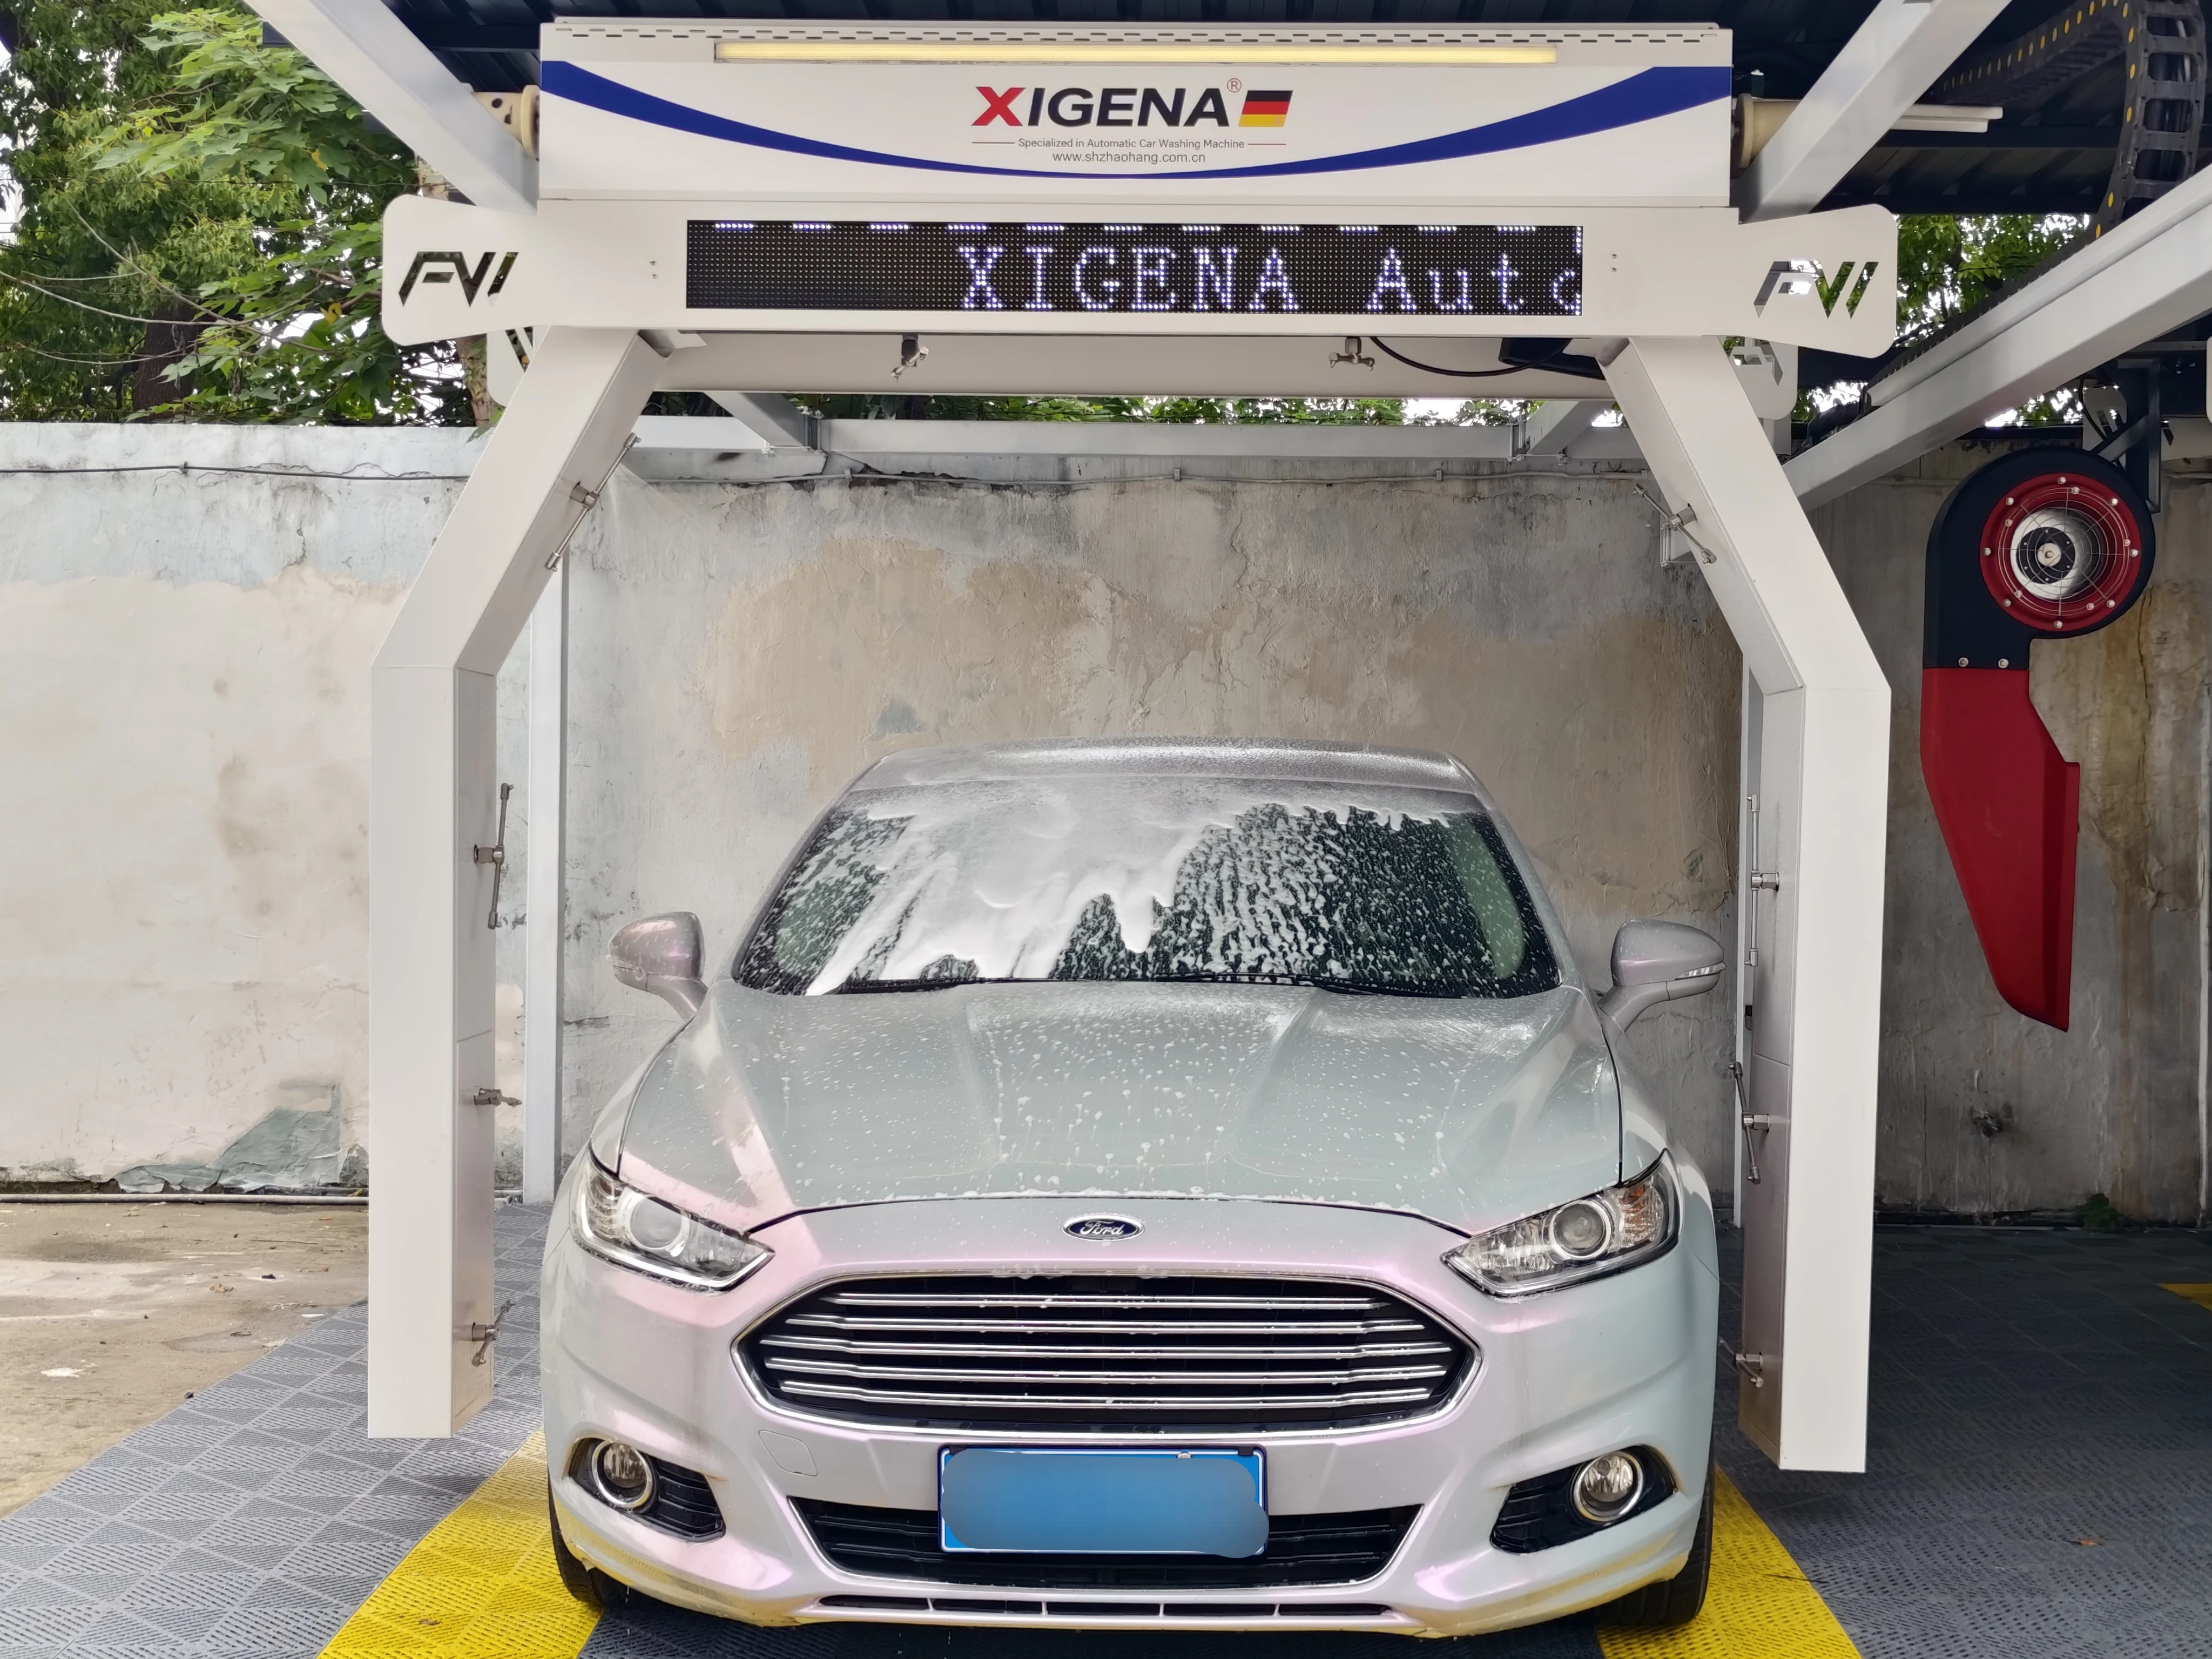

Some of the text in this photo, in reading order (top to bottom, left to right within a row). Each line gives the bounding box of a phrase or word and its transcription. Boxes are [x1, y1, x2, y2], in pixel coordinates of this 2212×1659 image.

[972, 86, 1230, 127] XIGENA
[1018, 138, 1245, 151] Specialized in Automatic Car Washing Machine
[1052, 151, 1206, 165] www.shzhaohang.com.cn
[959, 246, 1299, 309] XIGENA
[1080, 1219, 1125, 1236] Ford
